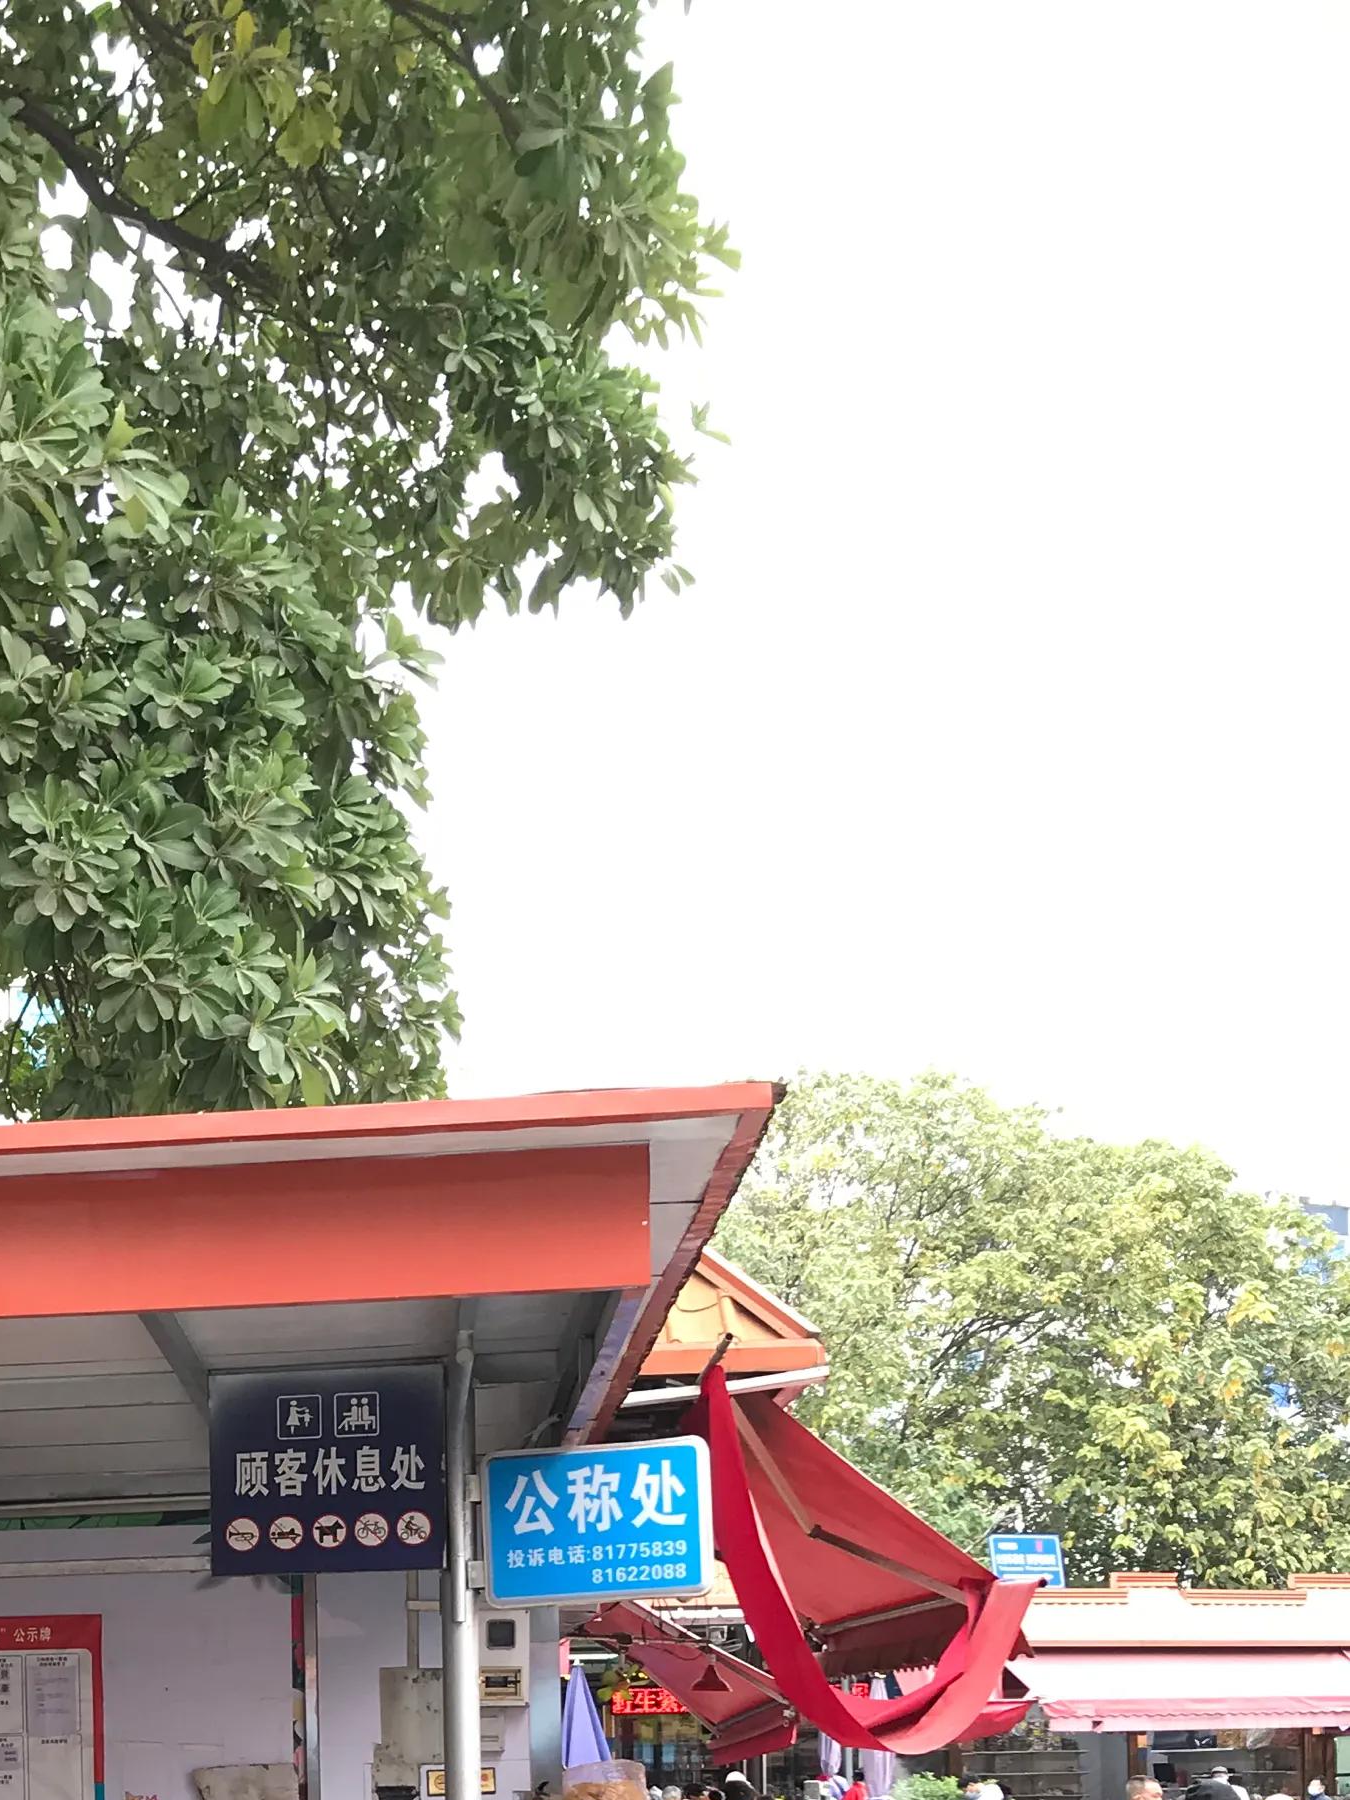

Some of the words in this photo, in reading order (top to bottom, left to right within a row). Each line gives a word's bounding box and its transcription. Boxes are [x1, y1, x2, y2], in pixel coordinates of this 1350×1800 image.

[235, 1445, 426, 1498] 顾客休息处
[505, 1459, 688, 1537] 公称处
[592, 1563, 687, 1584] 81622088
[13, 1626, 51, 1643] 公示牌
